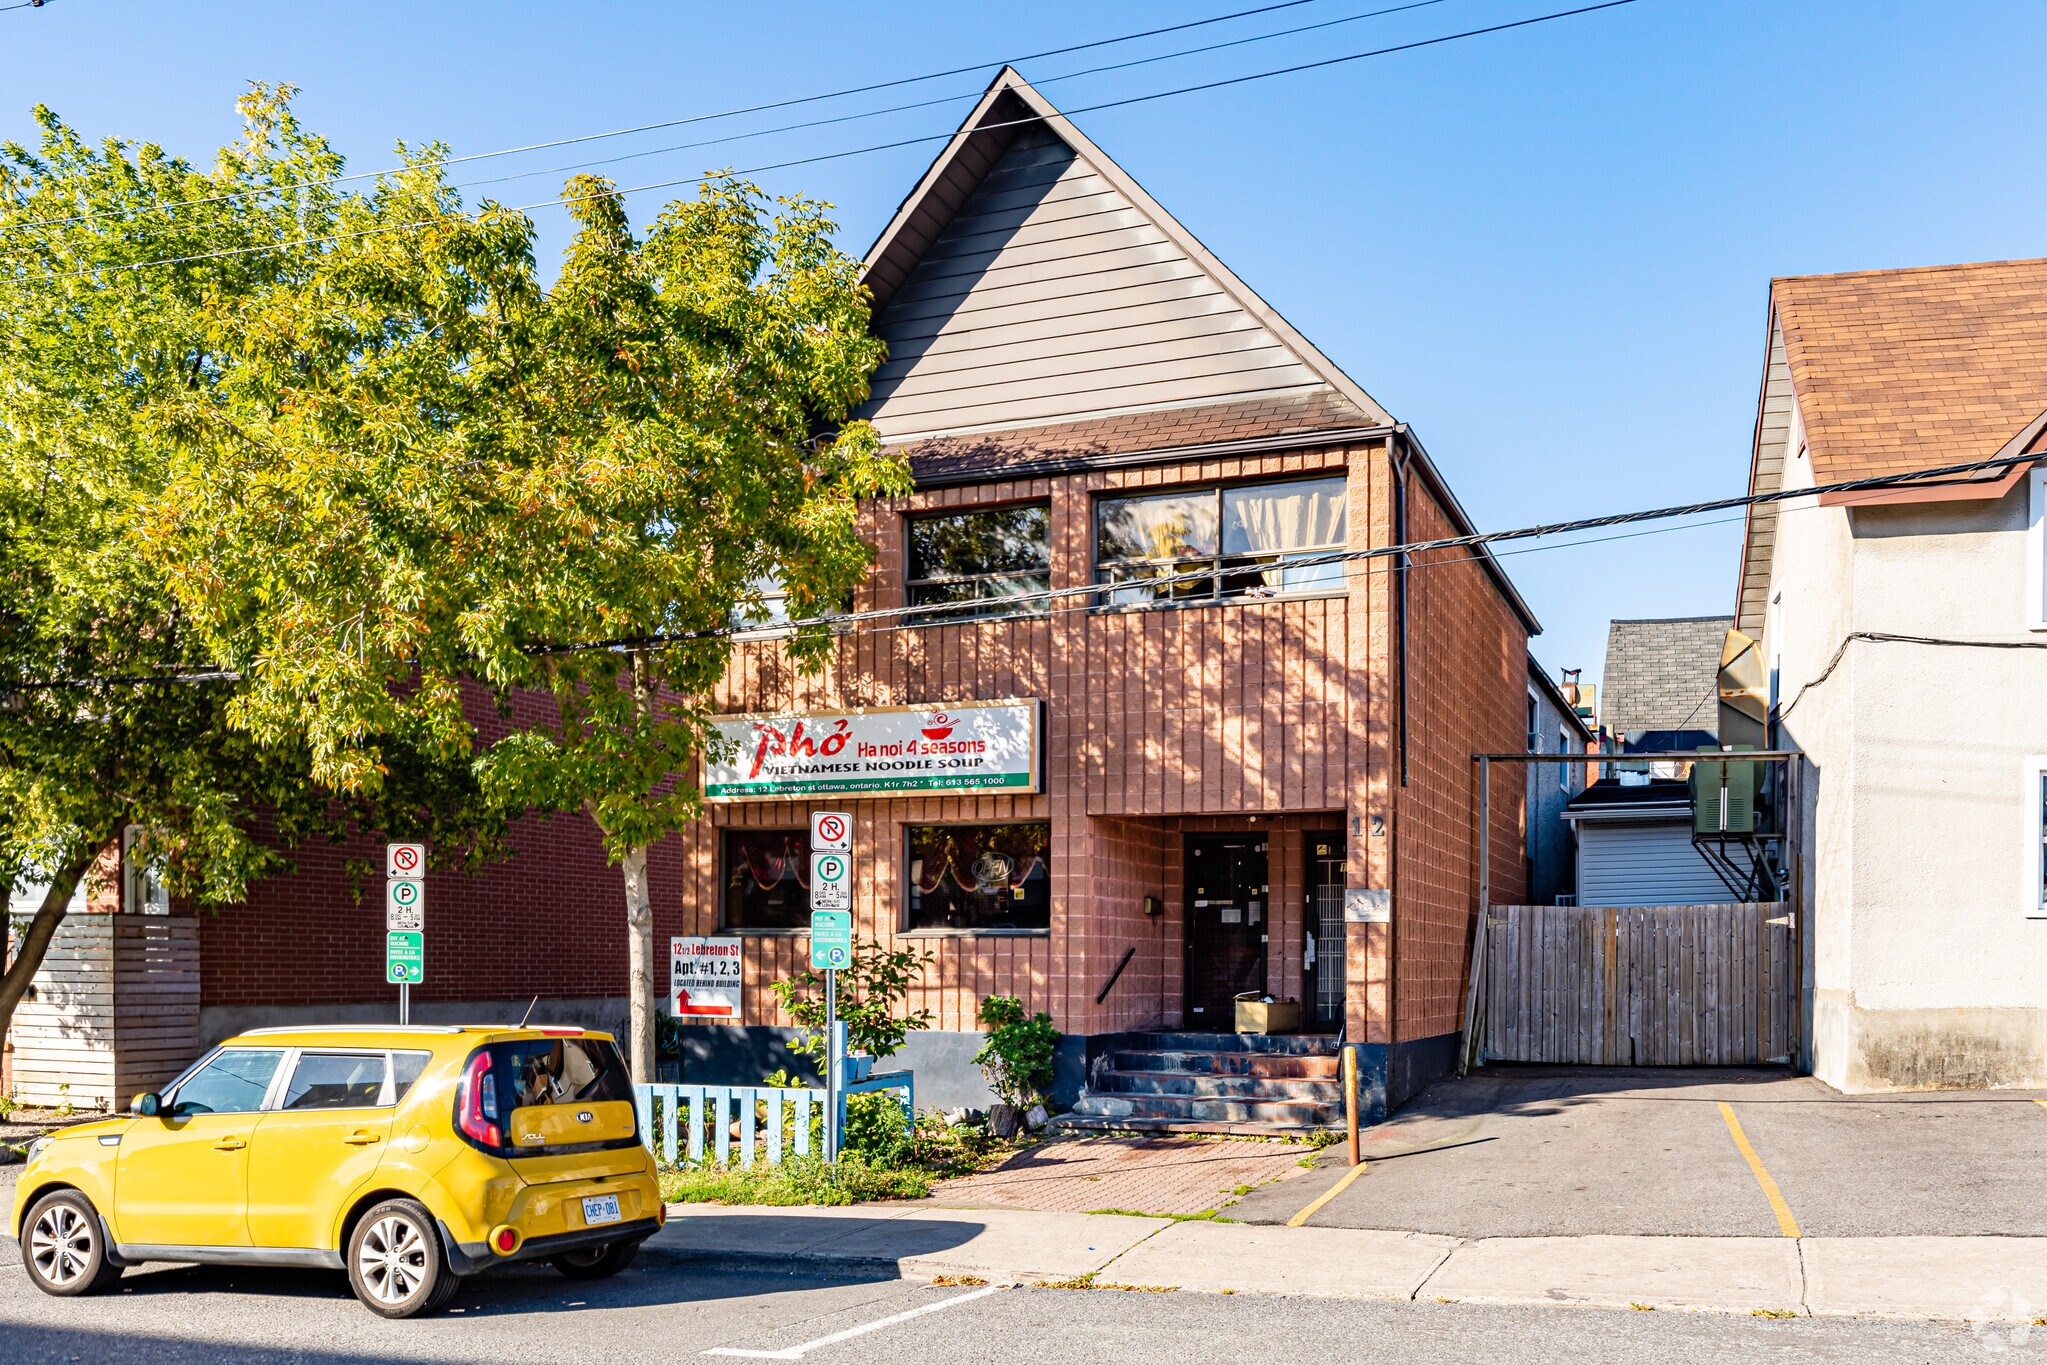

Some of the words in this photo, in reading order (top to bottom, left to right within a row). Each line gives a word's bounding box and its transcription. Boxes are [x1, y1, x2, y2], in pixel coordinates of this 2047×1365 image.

[906, 740, 917, 756] 4
[921, 740, 986, 755] seasons
[765, 762, 861, 775] VIETNAMESE
[865, 759, 933, 771] NOODLE
[938, 758, 984, 769] SOUP
[720, 786, 756, 794] Address:
[769, 784, 805, 793] Lebreton
[984, 777, 1004, 785] 1000
[1352, 816, 1385, 836] 12
[826, 862, 837, 875] P
[975, 859, 1010, 875] OPEN
[401, 888, 411, 900] P
[691, 943, 728, 956] Lebreton
[730, 944, 739, 956] St
[674, 960, 697, 975] Apt.
[733, 960, 740, 975] 3
[674, 979, 695, 987] LOCATED
[696, 979, 715, 987] BEHIND
[715, 980, 740, 988] BUILDING
[579, 1112, 592, 1121] KIA
[585, 1203, 602, 1217] CHEP
